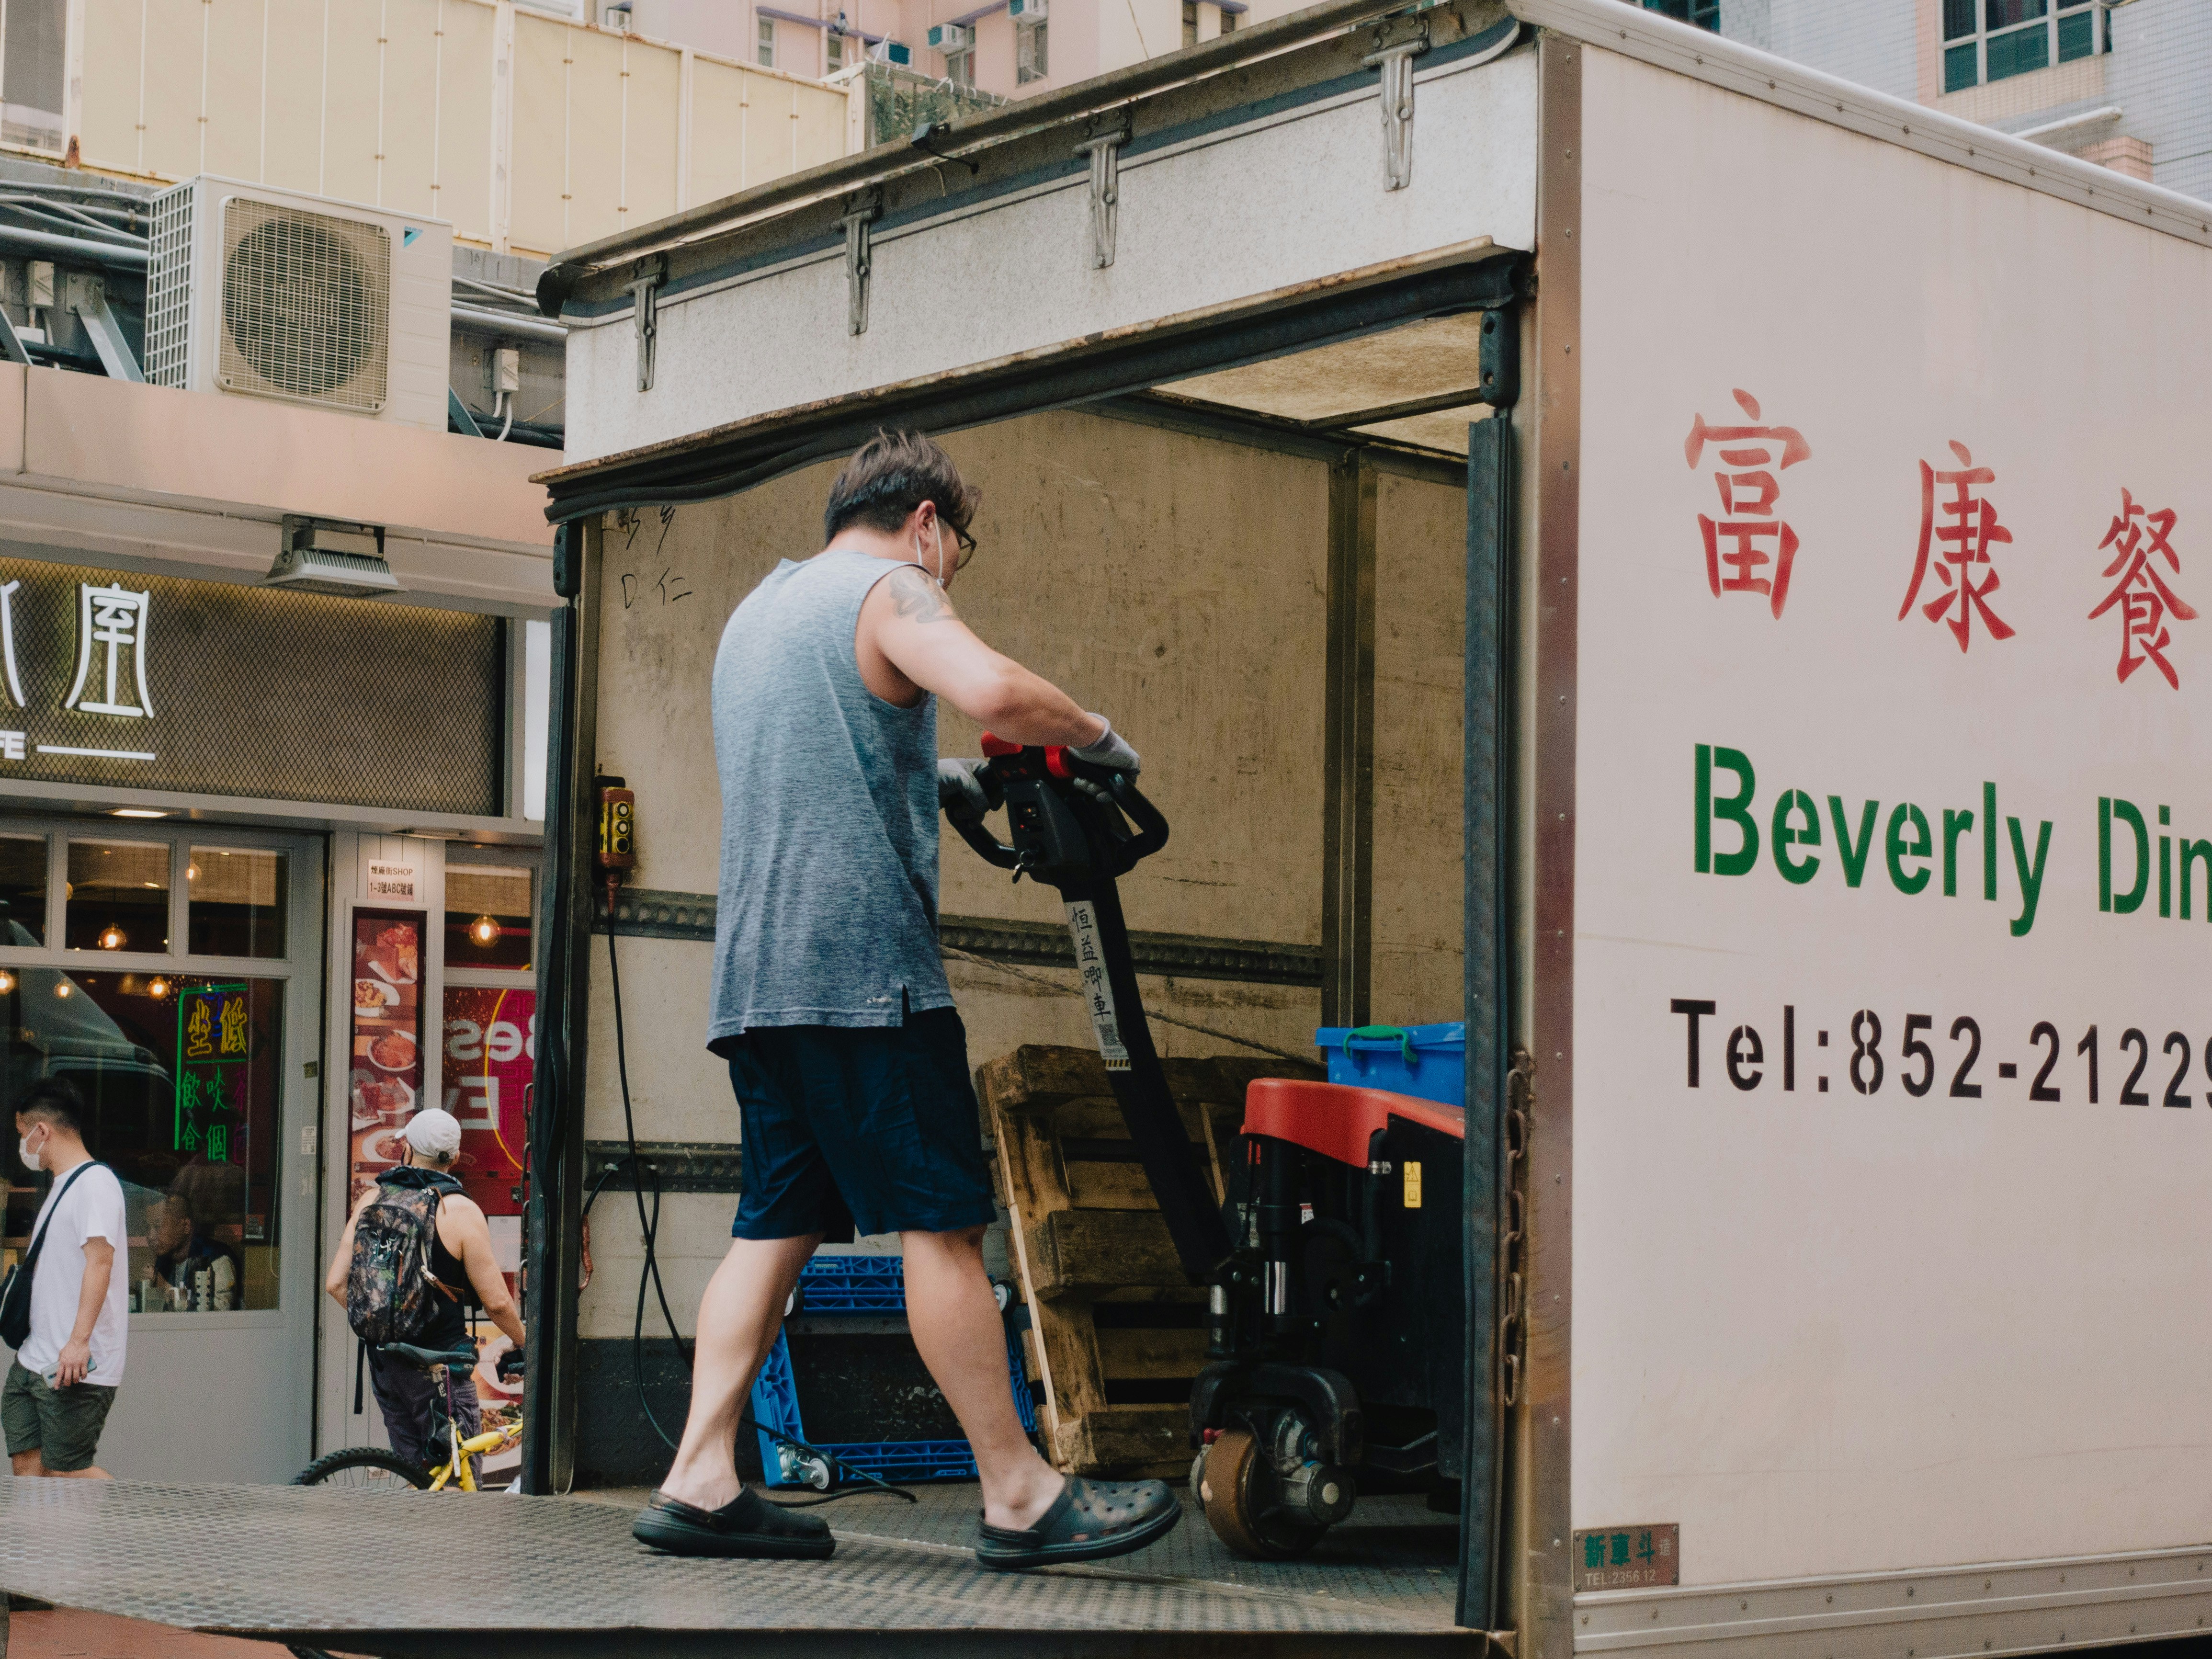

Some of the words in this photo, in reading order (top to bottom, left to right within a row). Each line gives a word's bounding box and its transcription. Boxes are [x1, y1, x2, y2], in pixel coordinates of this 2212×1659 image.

[1684, 387, 2200, 691] 富康餐
[1694, 742, 2053, 937] Beverly
[1670, 998, 2212, 1109] Tel:852-2122
